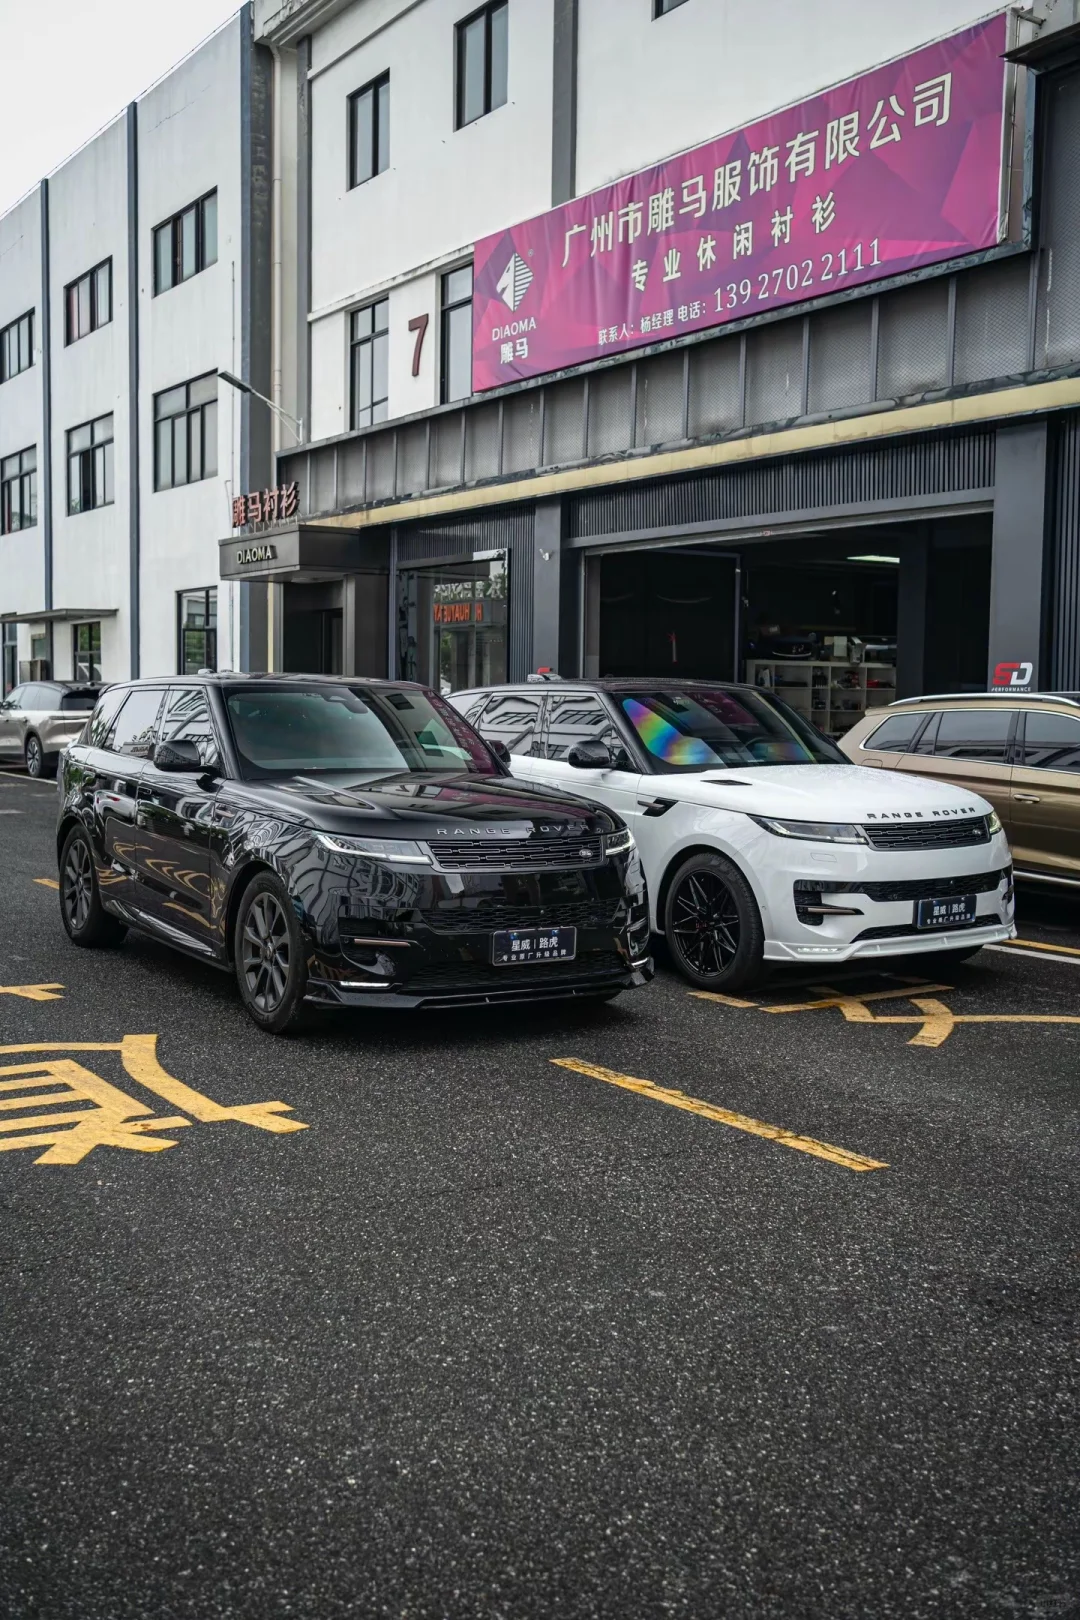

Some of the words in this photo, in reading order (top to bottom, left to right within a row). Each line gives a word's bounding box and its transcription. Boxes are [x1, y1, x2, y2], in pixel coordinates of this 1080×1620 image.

[562, 72, 952, 268] 广州市雕马服饰有限公司
[631, 191, 836, 292] 专业休闲衬衫
[714, 279, 752, 312] 139
[758, 259, 814, 300] 2702
[820, 237, 882, 281] 2111
[492, 317, 536, 341] DIAOMA
[408, 313, 429, 377] 7
[500, 337, 529, 364] 雕马
[232, 481, 297, 528] 雕马衬衫
[237, 545, 272, 564] DIAOMA
[993, 662, 1033, 685] SD
[867, 811, 923, 819] RANGE
[932, 807, 975, 816] ROVER
[437, 827, 511, 835] RANGE
[526, 824, 590, 833] ROVER
[539, 936, 559, 949] 路虎
